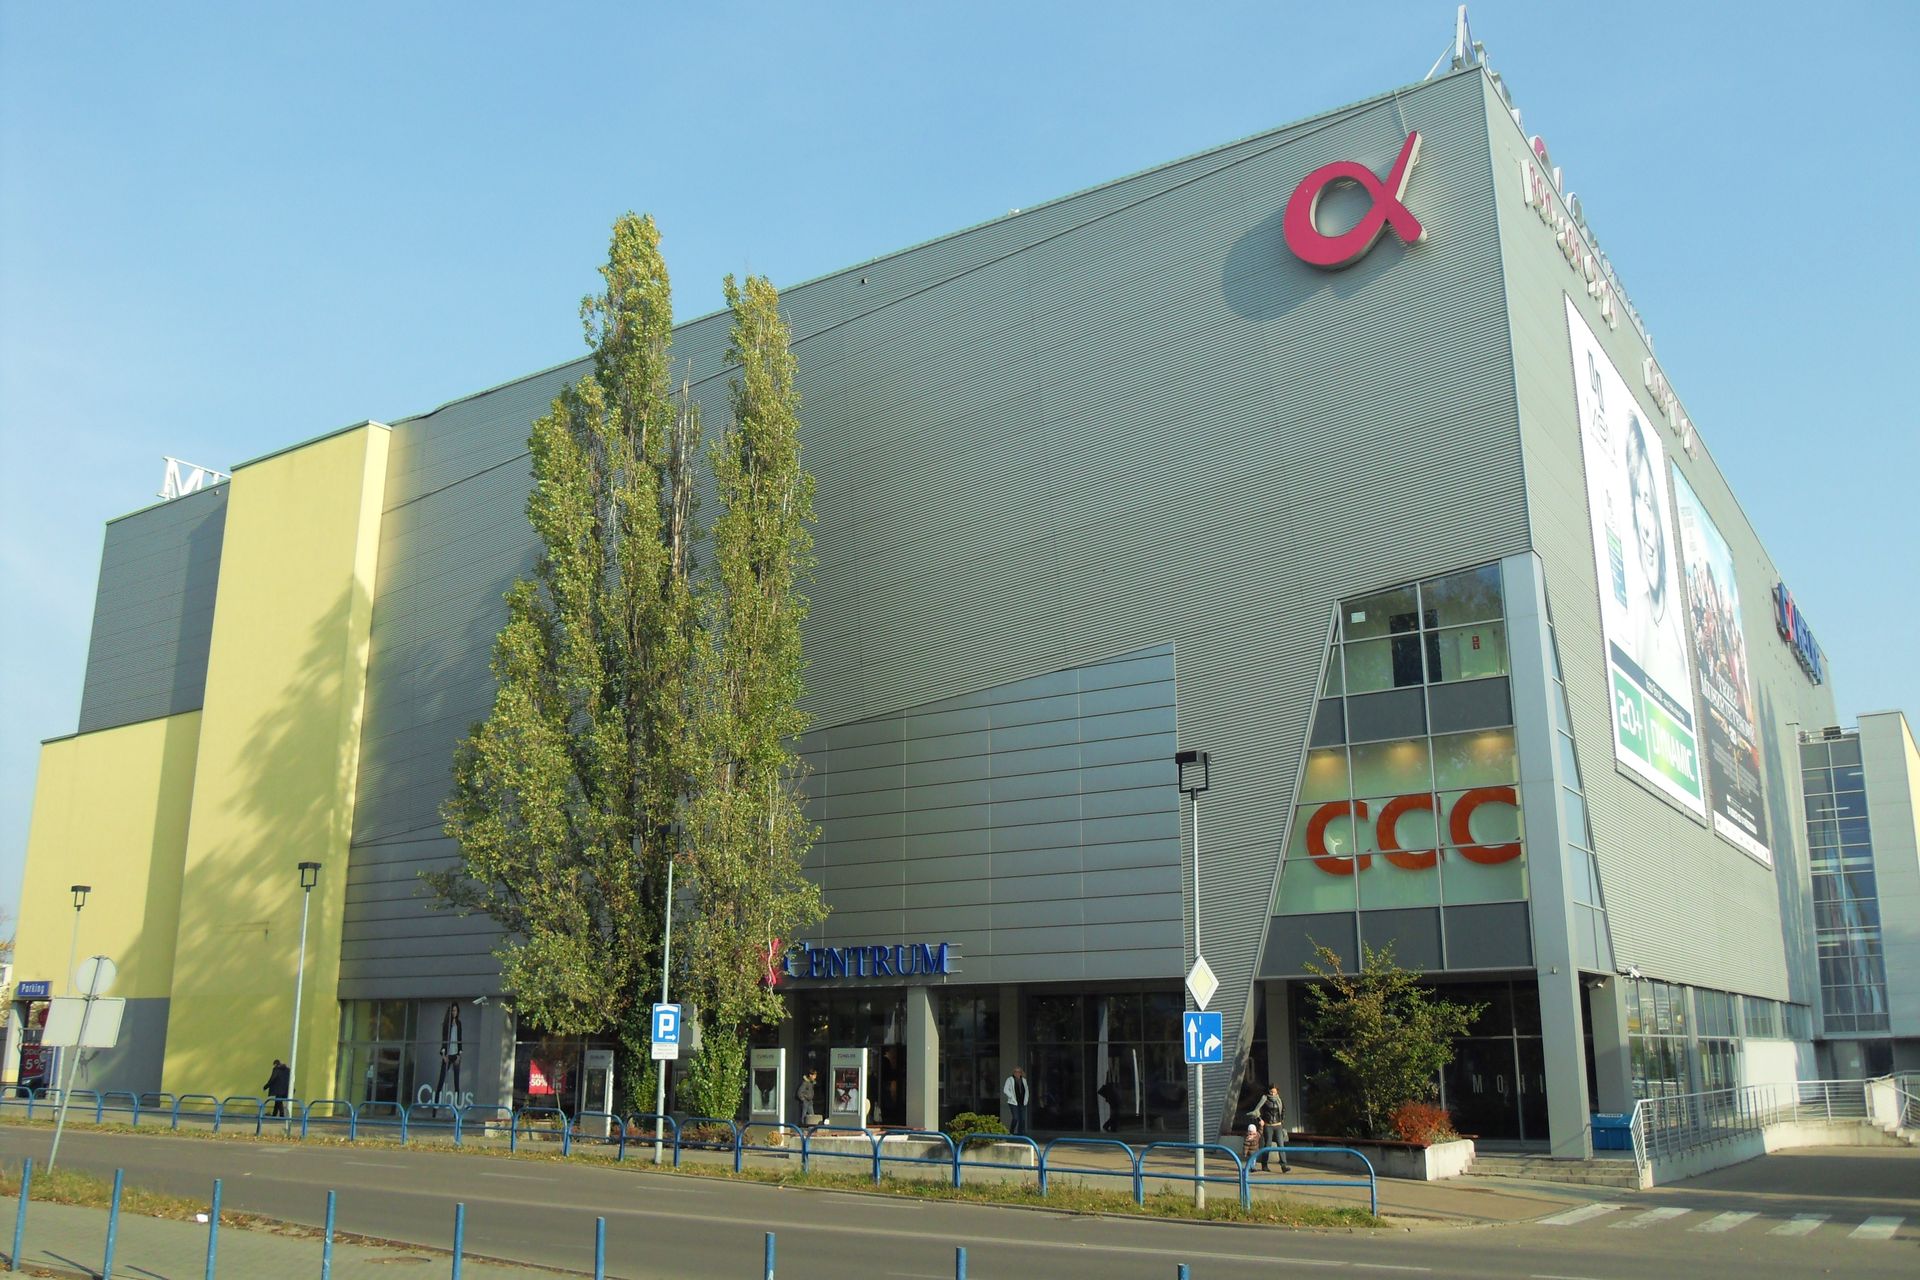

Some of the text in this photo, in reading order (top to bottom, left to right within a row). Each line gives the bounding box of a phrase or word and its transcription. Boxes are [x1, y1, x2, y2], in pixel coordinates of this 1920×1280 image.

[1617, 688, 1643, 741] 20+
[1306, 786, 1522, 877] CCC
[783, 942, 950, 979] CENTRUM
[21, 983, 45, 995] Parking
[658, 1013, 675, 1039] P
[417, 1083, 475, 1110] Cubus
